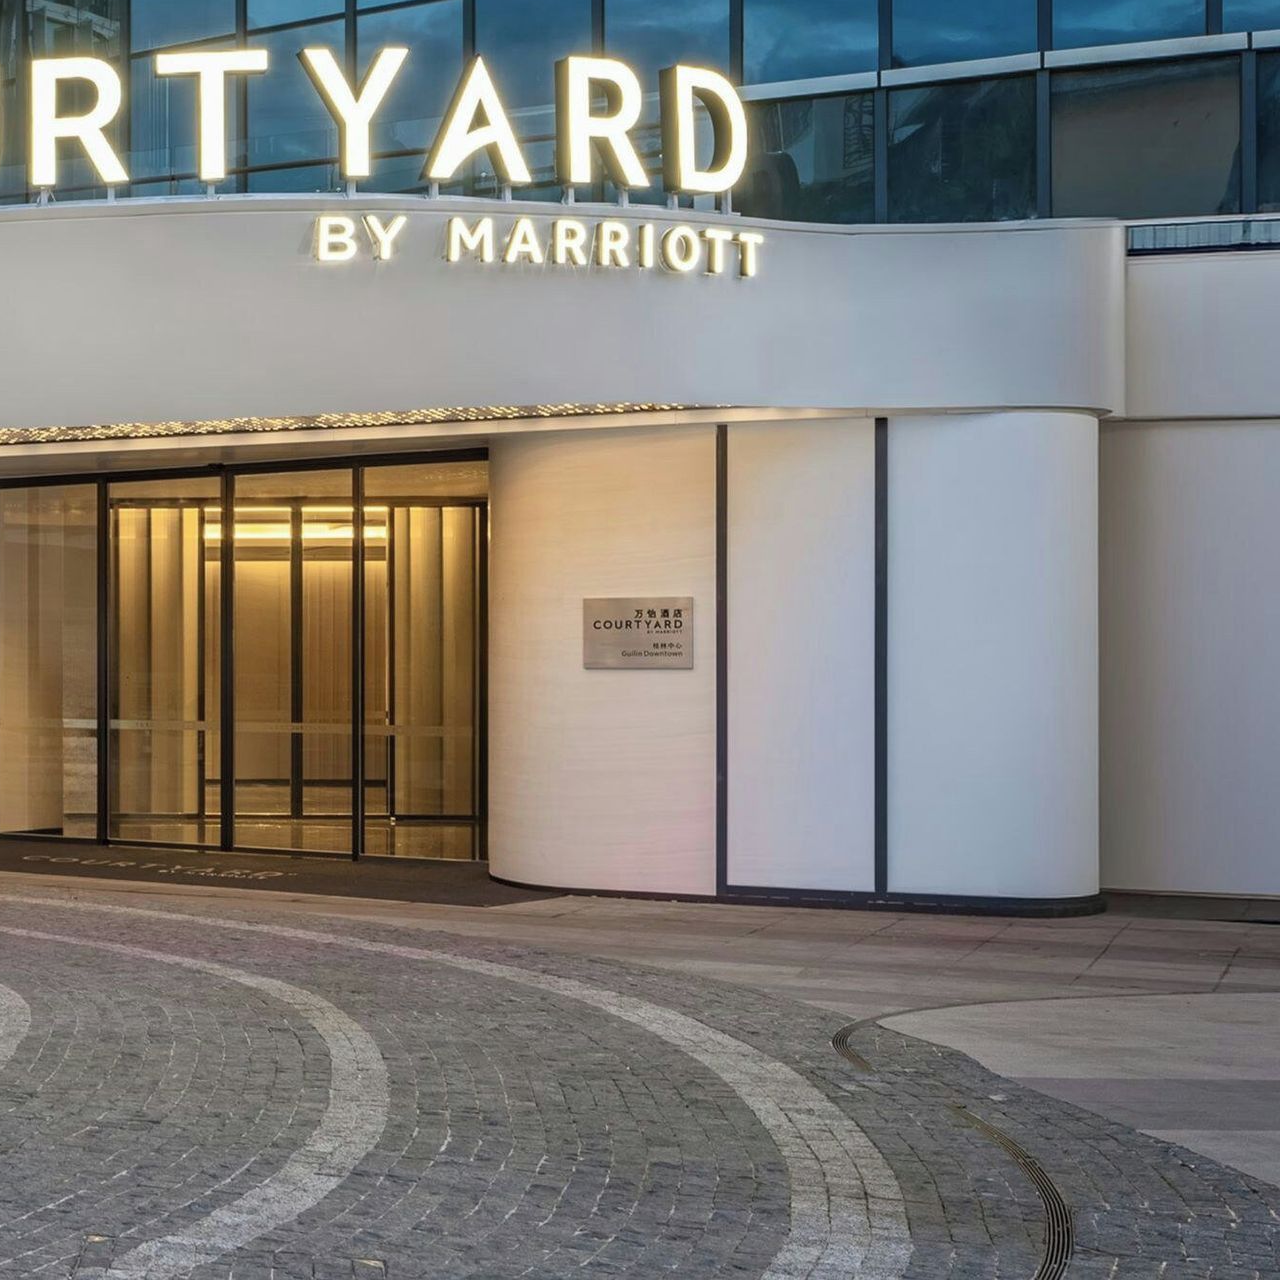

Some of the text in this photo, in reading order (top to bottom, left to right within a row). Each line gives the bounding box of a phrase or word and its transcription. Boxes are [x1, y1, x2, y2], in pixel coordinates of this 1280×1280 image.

[317, 215, 764, 277] BY MARRIOTT
[634, 608, 683, 618] 万怡酒店
[593, 619, 683, 630] COURTYARD
